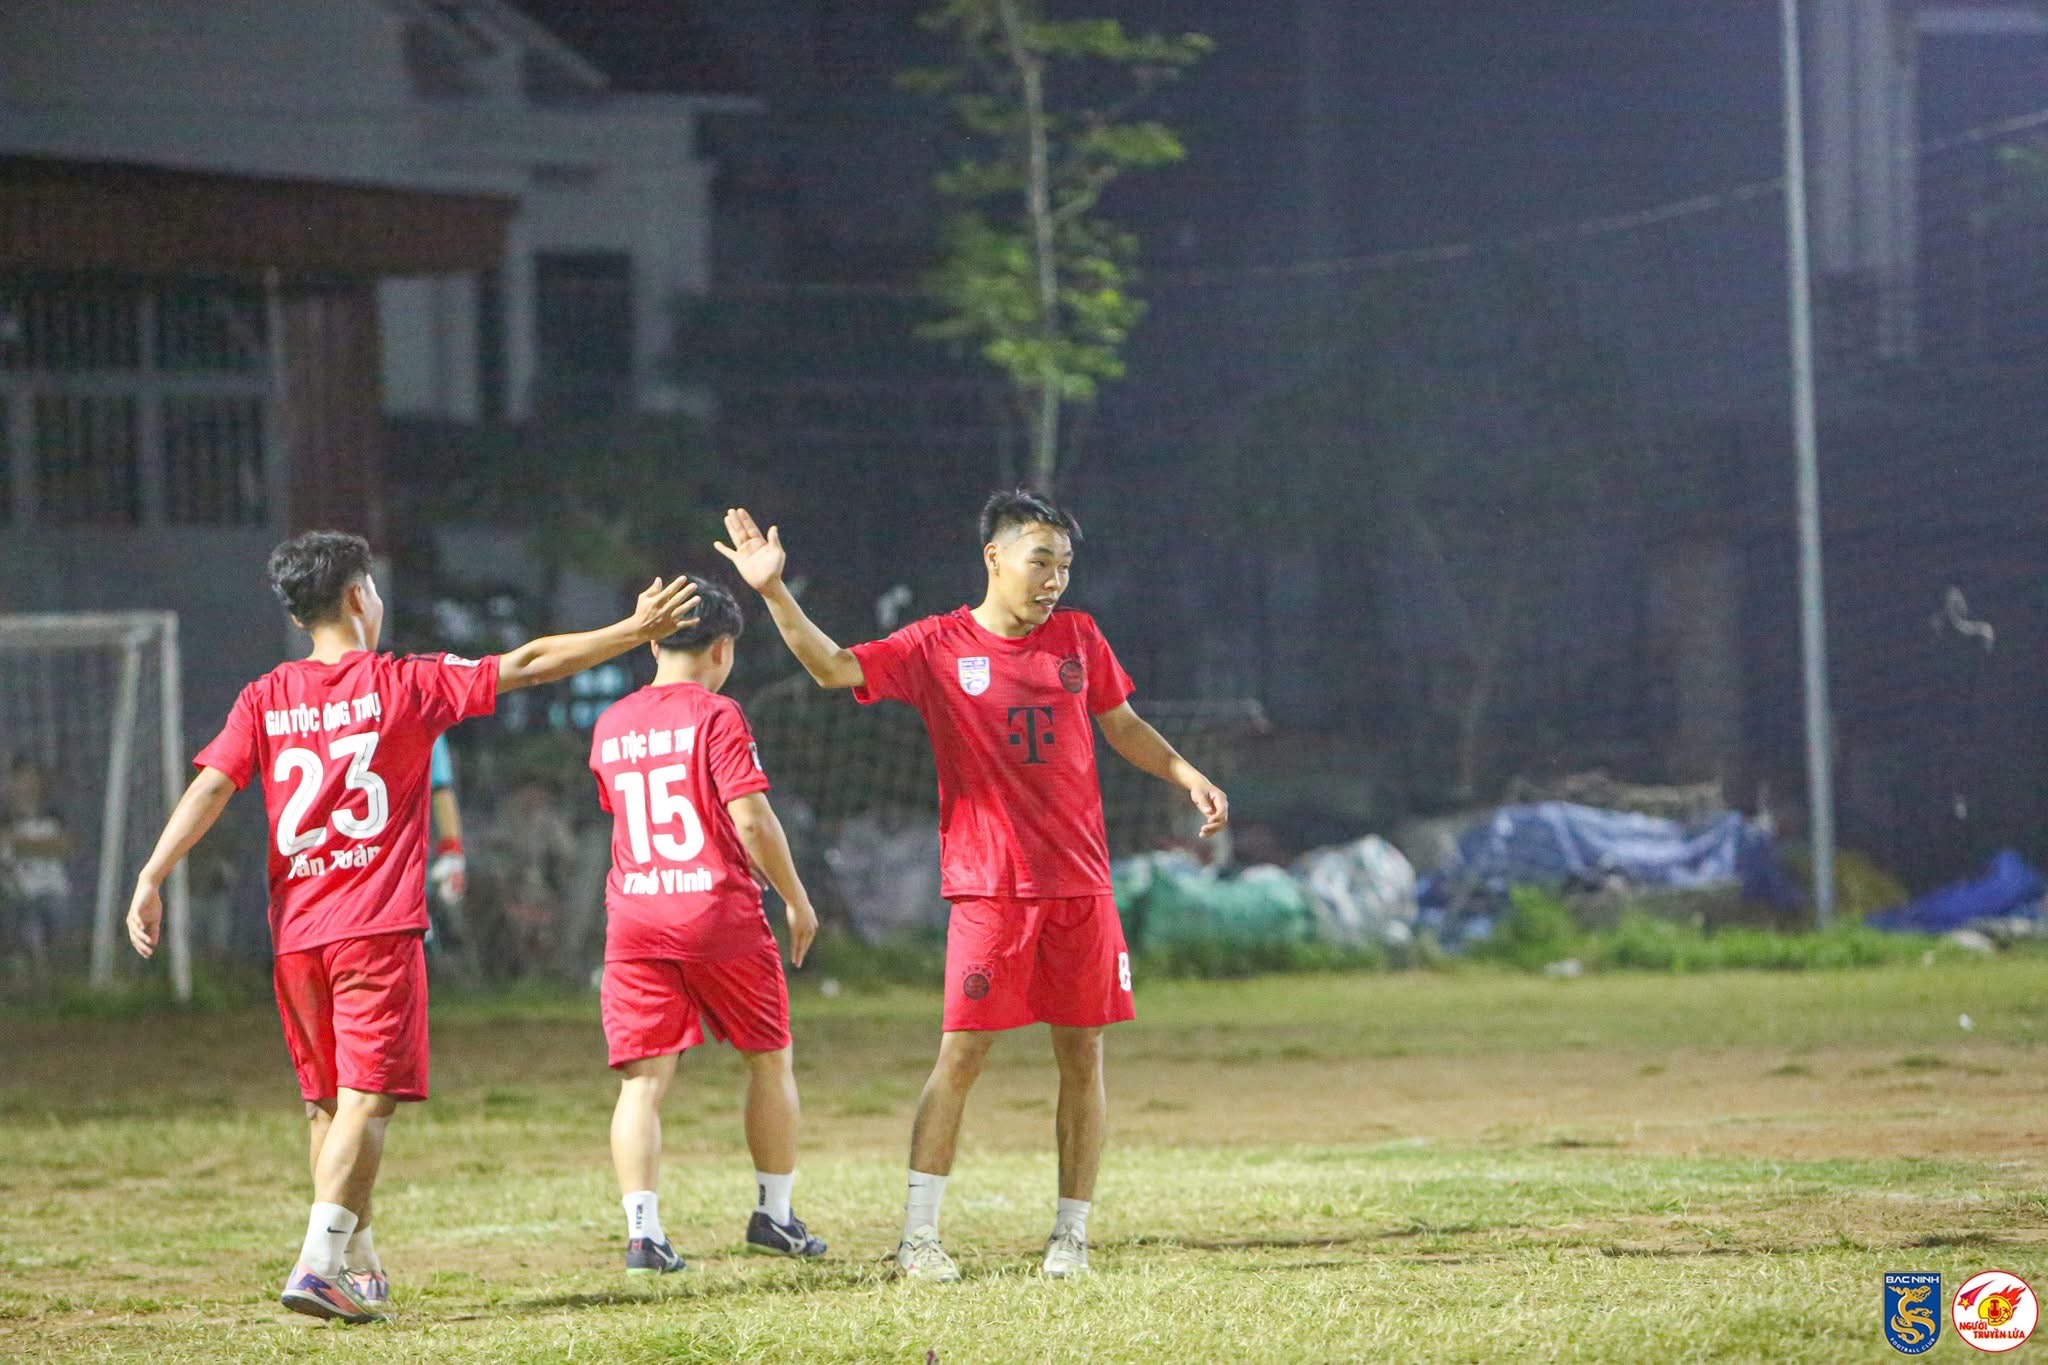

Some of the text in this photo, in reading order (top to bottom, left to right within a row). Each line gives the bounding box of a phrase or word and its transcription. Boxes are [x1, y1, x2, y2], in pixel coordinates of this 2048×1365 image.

[265, 710, 291, 736] GIA
[290, 702, 320, 738] TỘC
[323, 701, 351, 732] ÔNG
[621, 729, 647, 764] TỘC
[274, 731, 389, 857] 23
[614, 764, 705, 864] 15
